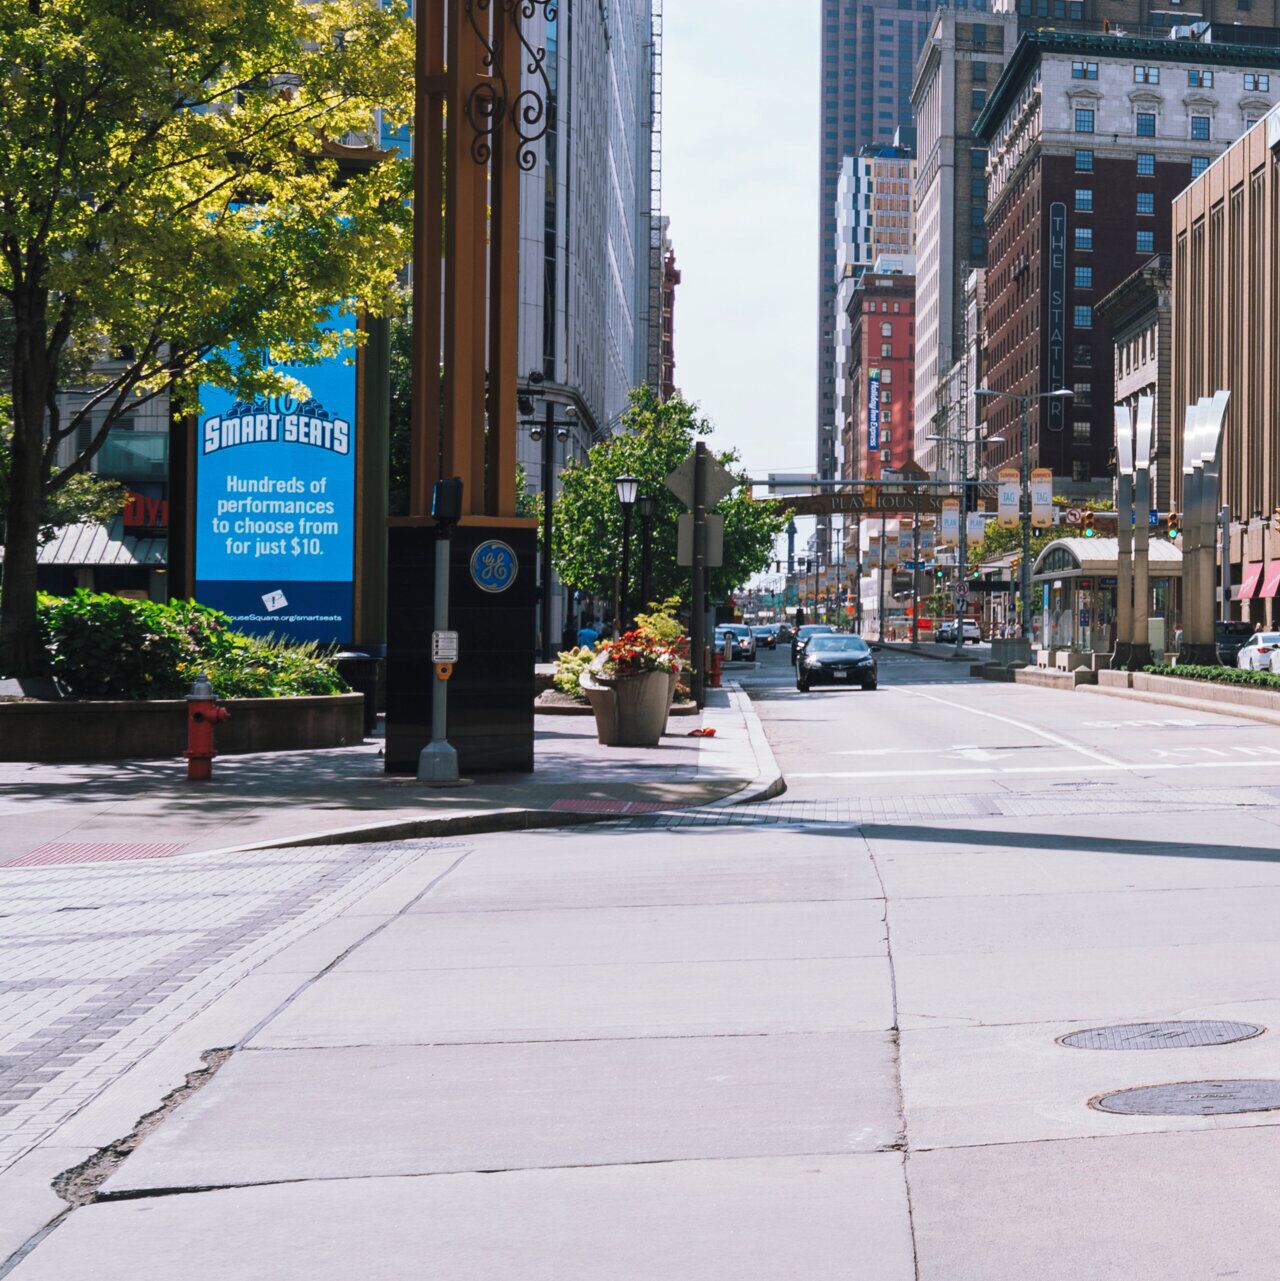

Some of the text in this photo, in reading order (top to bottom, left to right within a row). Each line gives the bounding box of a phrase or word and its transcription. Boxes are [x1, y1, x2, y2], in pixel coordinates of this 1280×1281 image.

[1052, 217, 1064, 269] THE
[869, 381, 879, 446] Holiday Inn Express
[203, 414, 350, 456] SMART SEATS
[226, 475, 327, 494] Hundreds of
[217, 497, 335, 516] performances
[831, 496, 922, 509] PLAYOUS
[1003, 492, 1015, 503] TAG
[1035, 492, 1048, 503] TAG
[212, 517, 339, 535] to choose from
[225, 537, 324, 558] for just $10.
